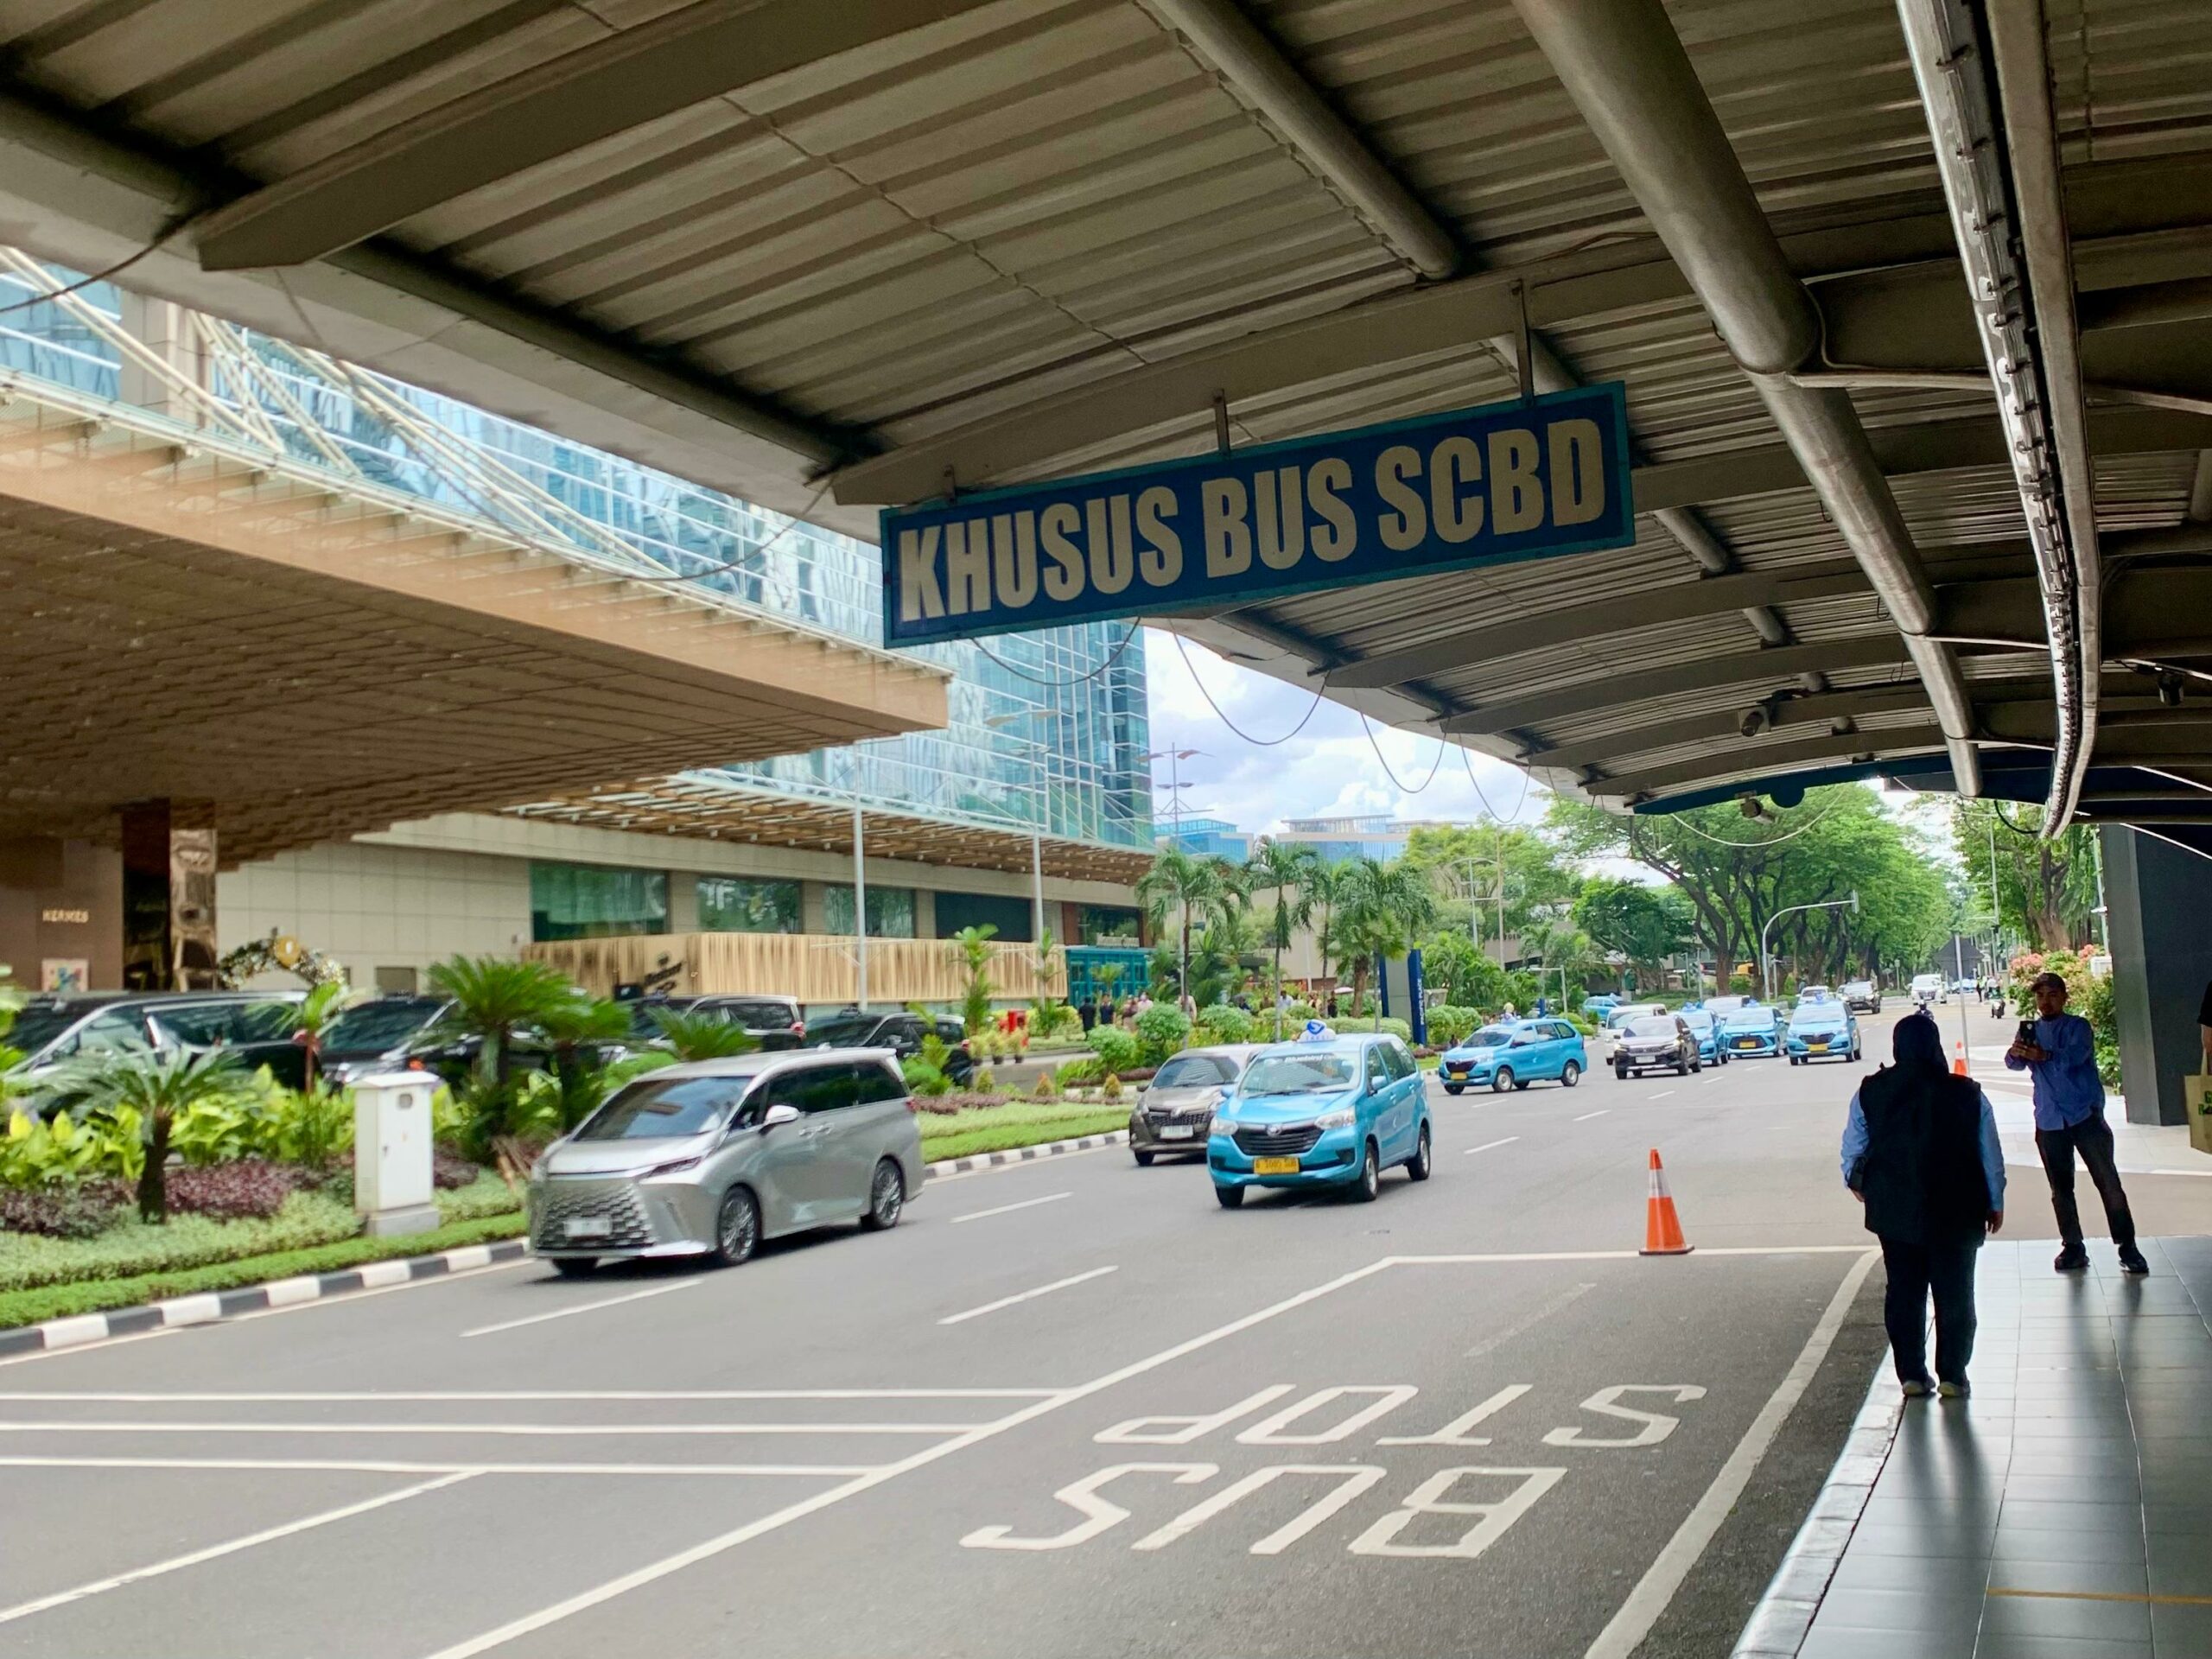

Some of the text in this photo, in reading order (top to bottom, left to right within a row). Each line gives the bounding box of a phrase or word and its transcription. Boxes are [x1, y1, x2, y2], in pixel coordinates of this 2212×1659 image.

[899, 418, 1606, 623] KHUSUS BUS SCBD
[1093, 1383, 1707, 1448] STOP
[959, 1462, 1567, 1558] BUS
